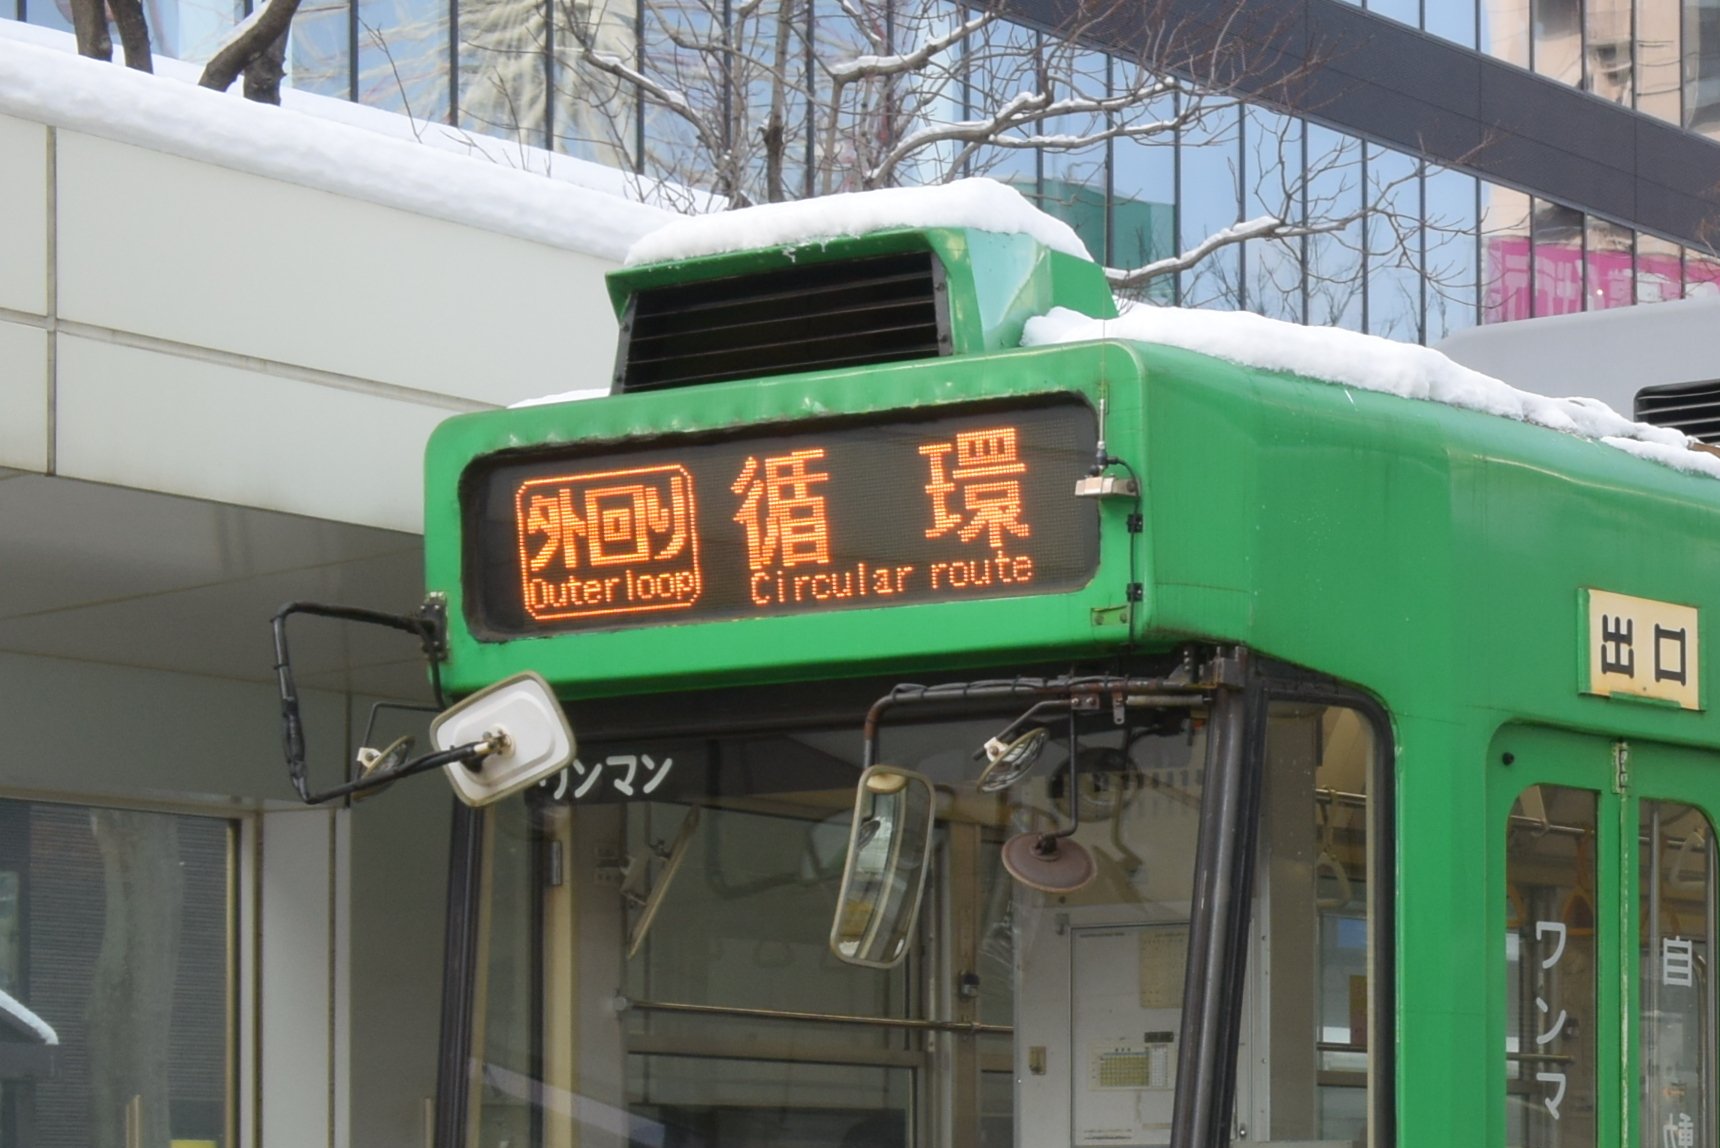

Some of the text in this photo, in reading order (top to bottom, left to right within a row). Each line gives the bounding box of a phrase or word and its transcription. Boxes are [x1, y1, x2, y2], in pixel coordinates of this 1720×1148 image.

[527, 427, 1029, 571] 外回り 循環
[529, 550, 1035, 613] Outer loop Circular route
[1600, 613, 1687, 687] 出口
